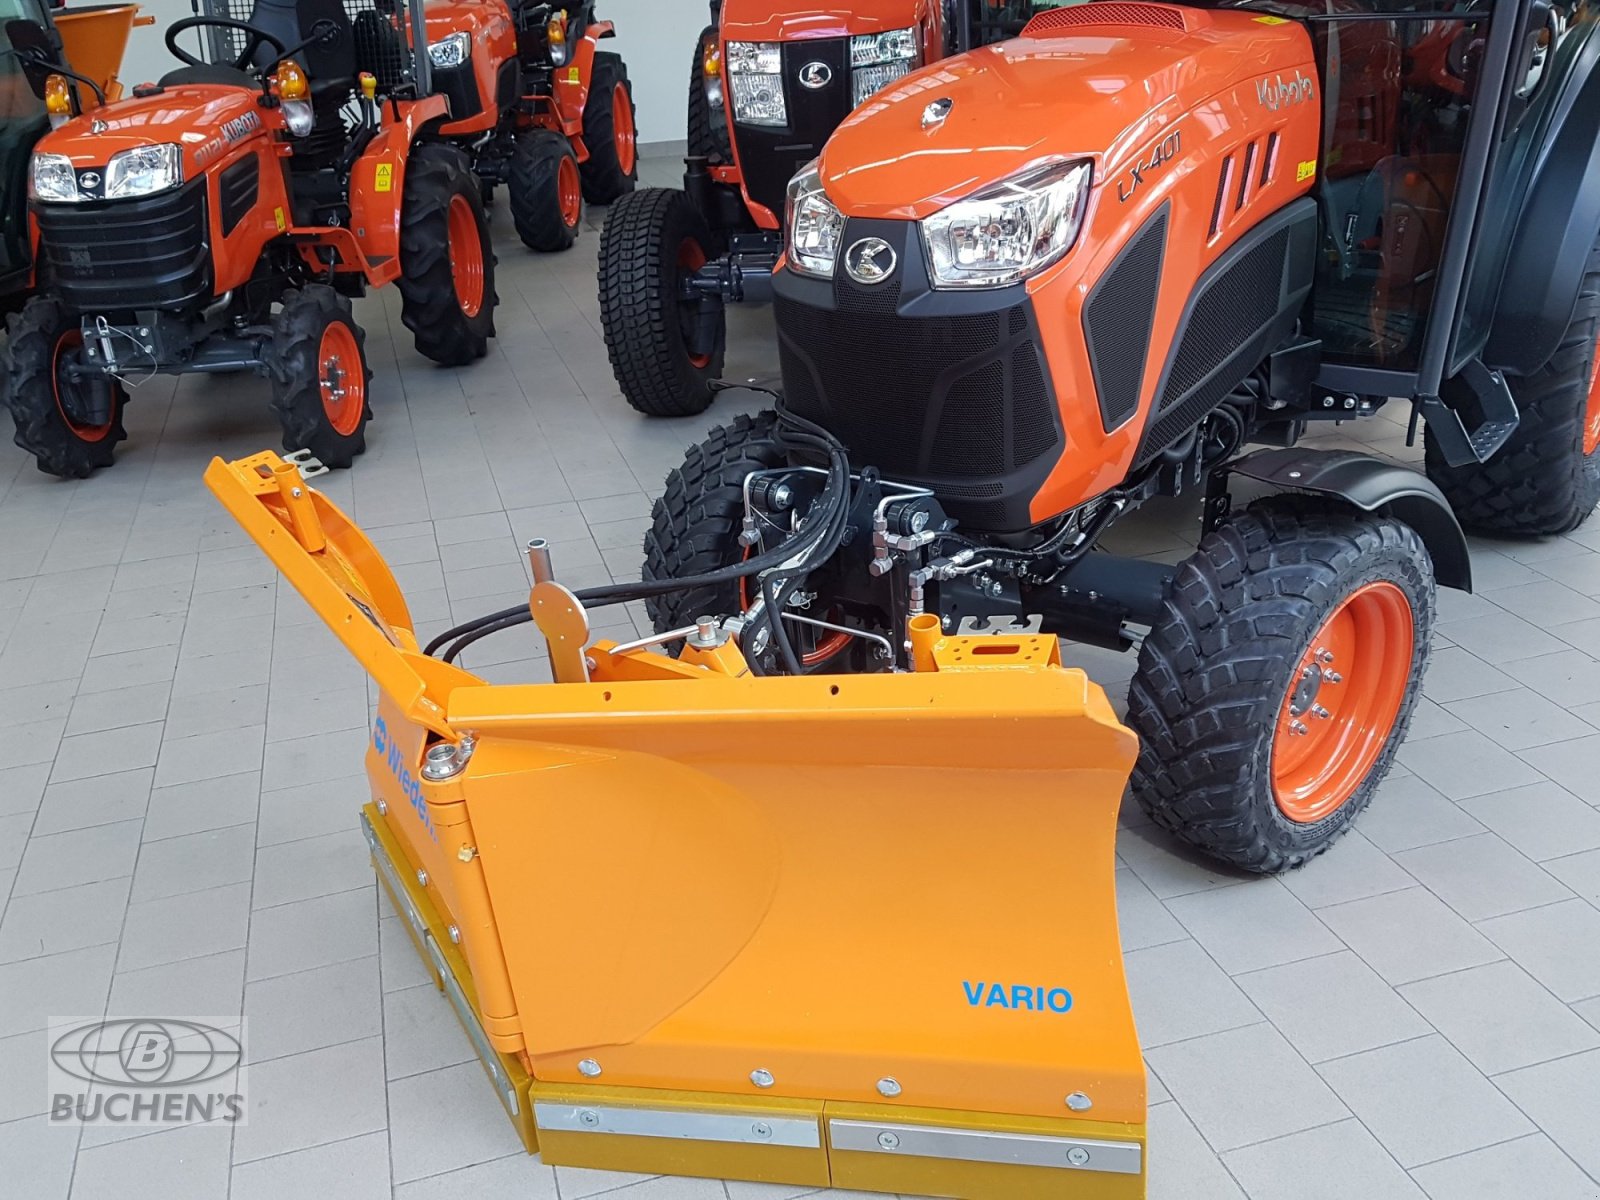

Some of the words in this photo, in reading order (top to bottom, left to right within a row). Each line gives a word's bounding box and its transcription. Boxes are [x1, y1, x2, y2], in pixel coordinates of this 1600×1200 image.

[1255, 70, 1314, 111] Kubota
[219, 110, 262, 143] KUBOTA
[1117, 129, 1182, 204] LX-401
[386, 735, 438, 843] Wiede
[962, 981, 1073, 1013] VARIO
